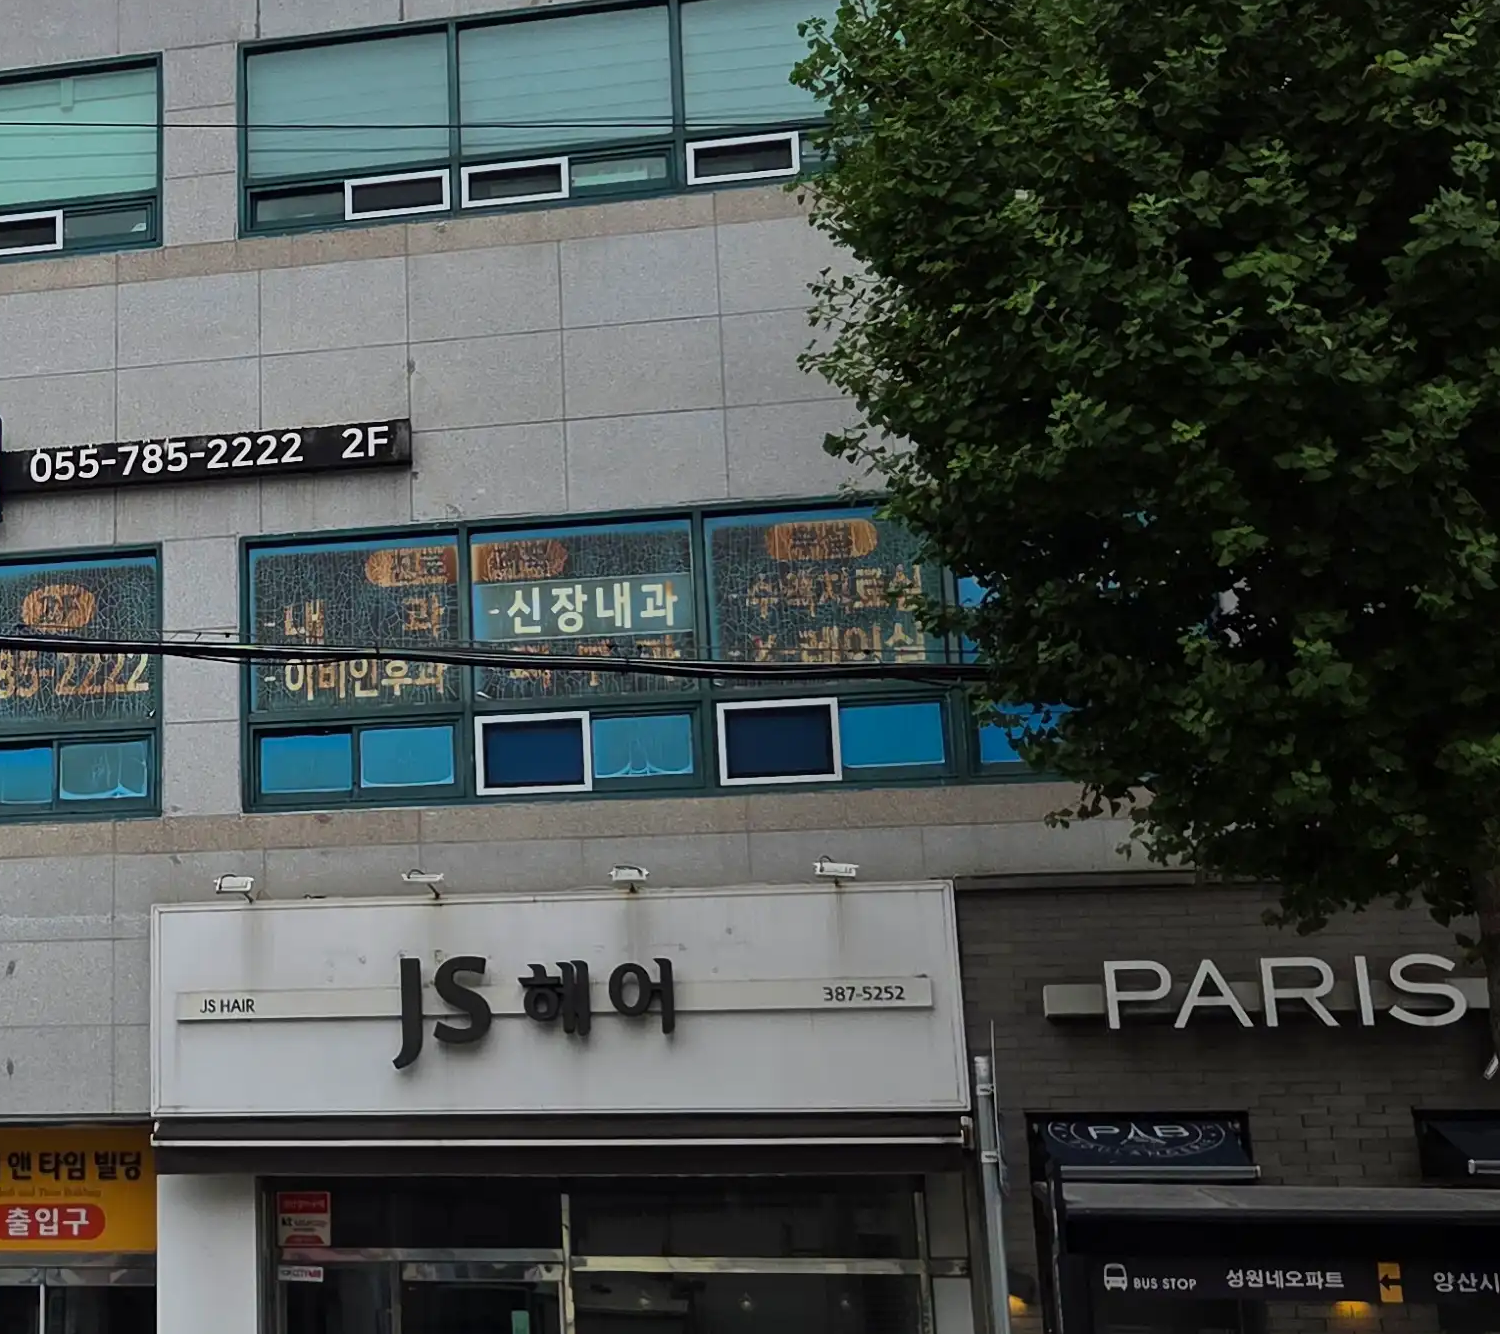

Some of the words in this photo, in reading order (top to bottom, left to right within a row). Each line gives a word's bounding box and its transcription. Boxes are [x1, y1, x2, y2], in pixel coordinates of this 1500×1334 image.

[29, 432, 304, 486] 055-785-2222
[340, 426, 391, 460] 2F
[506, 580, 679, 635] 신장내과
[199, 999, 217, 1014] JS
[220, 998, 255, 1014] HAIR
[822, 984, 906, 1003] 387-5252
[1104, 953, 1468, 1030] PARIS
[393, 956, 492, 1071] JS
[518, 957, 676, 1036] 헤어
[7, 1151, 32, 1181] 앤
[38, 1151, 86, 1181] 타임
[94, 1151, 142, 1181] 빌딩
[5, 1207, 90, 1237] 출입구
[1133, 1276, 1159, 1290] BUS
[1162, 1277, 1197, 1291] STOP
